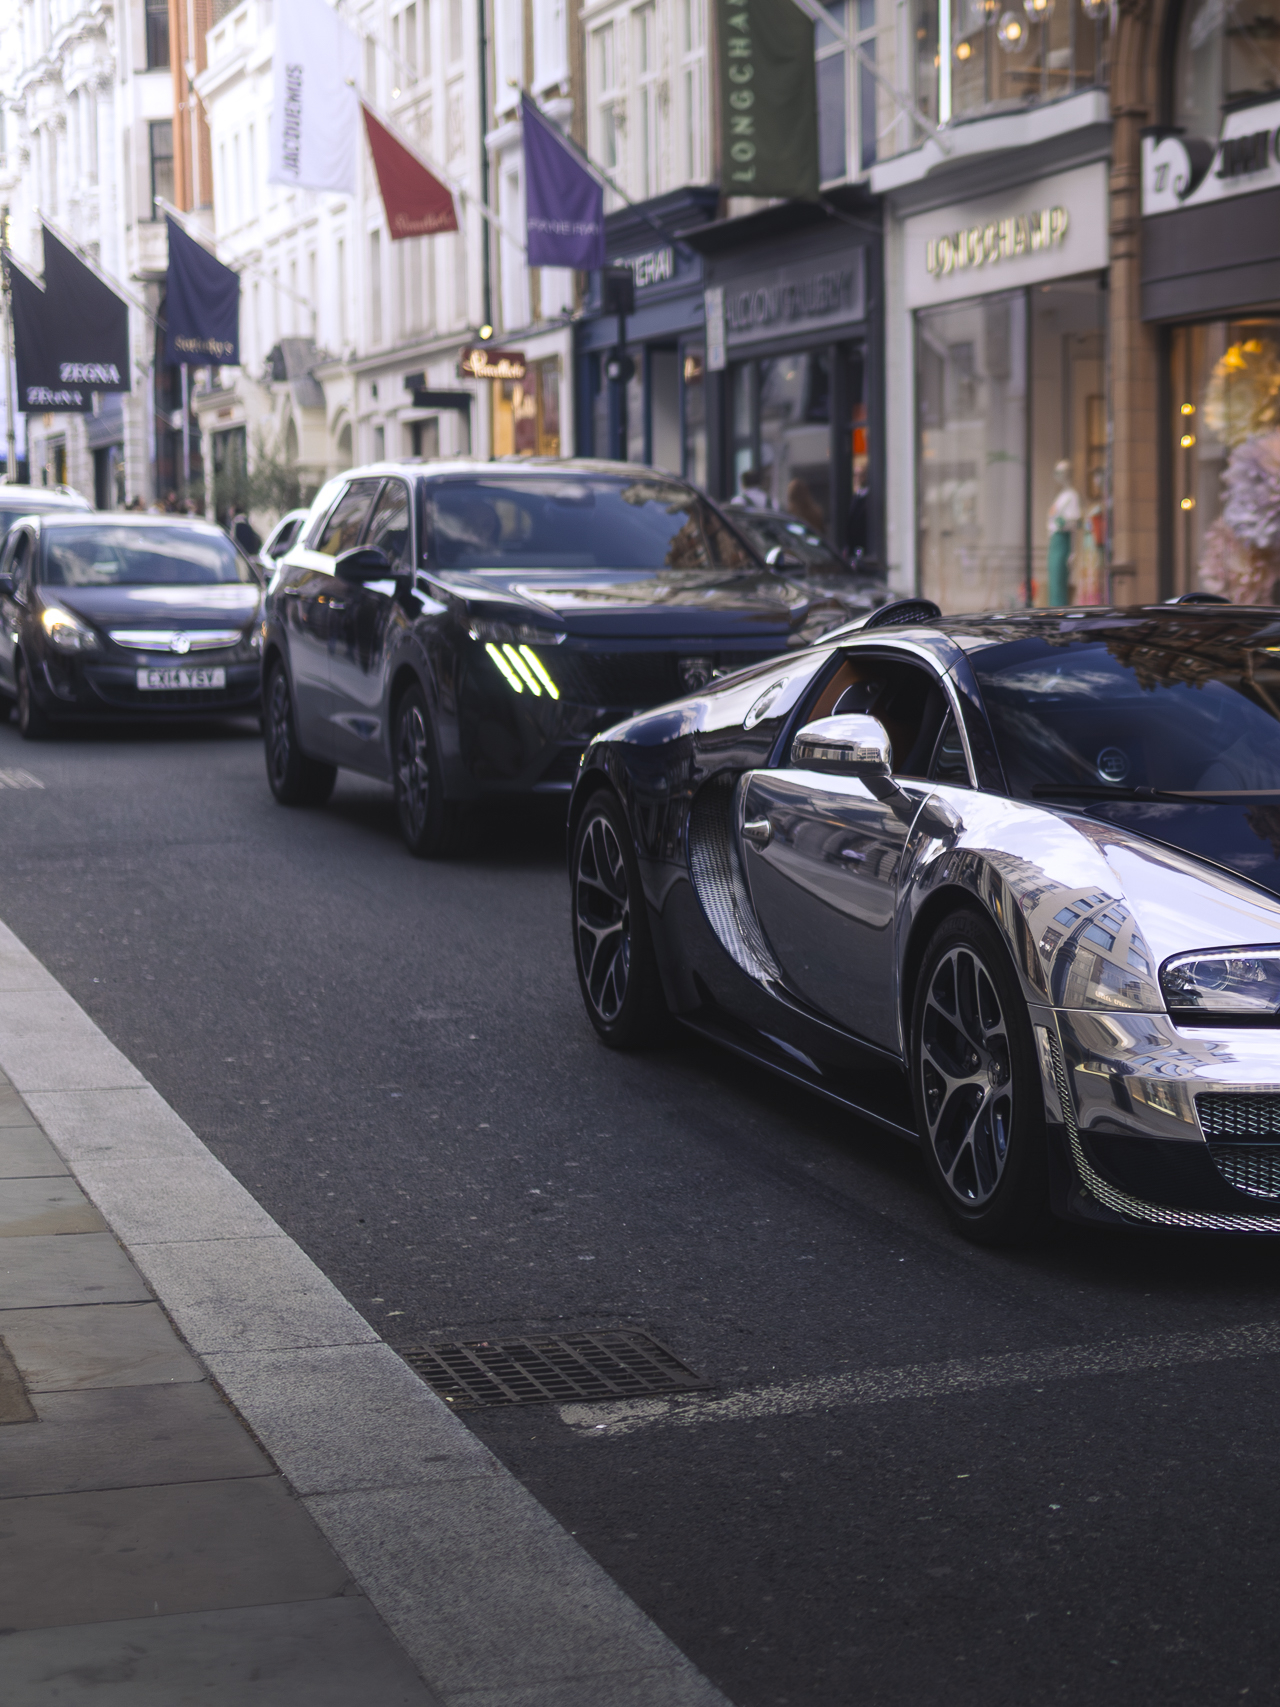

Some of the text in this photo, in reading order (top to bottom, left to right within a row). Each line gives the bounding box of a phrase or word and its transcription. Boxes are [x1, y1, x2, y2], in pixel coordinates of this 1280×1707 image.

[727, 0, 756, 183] LONGCHA
[927, 206, 1067, 277] LONGCHAMP
[59, 362, 120, 384] ZEGNA
